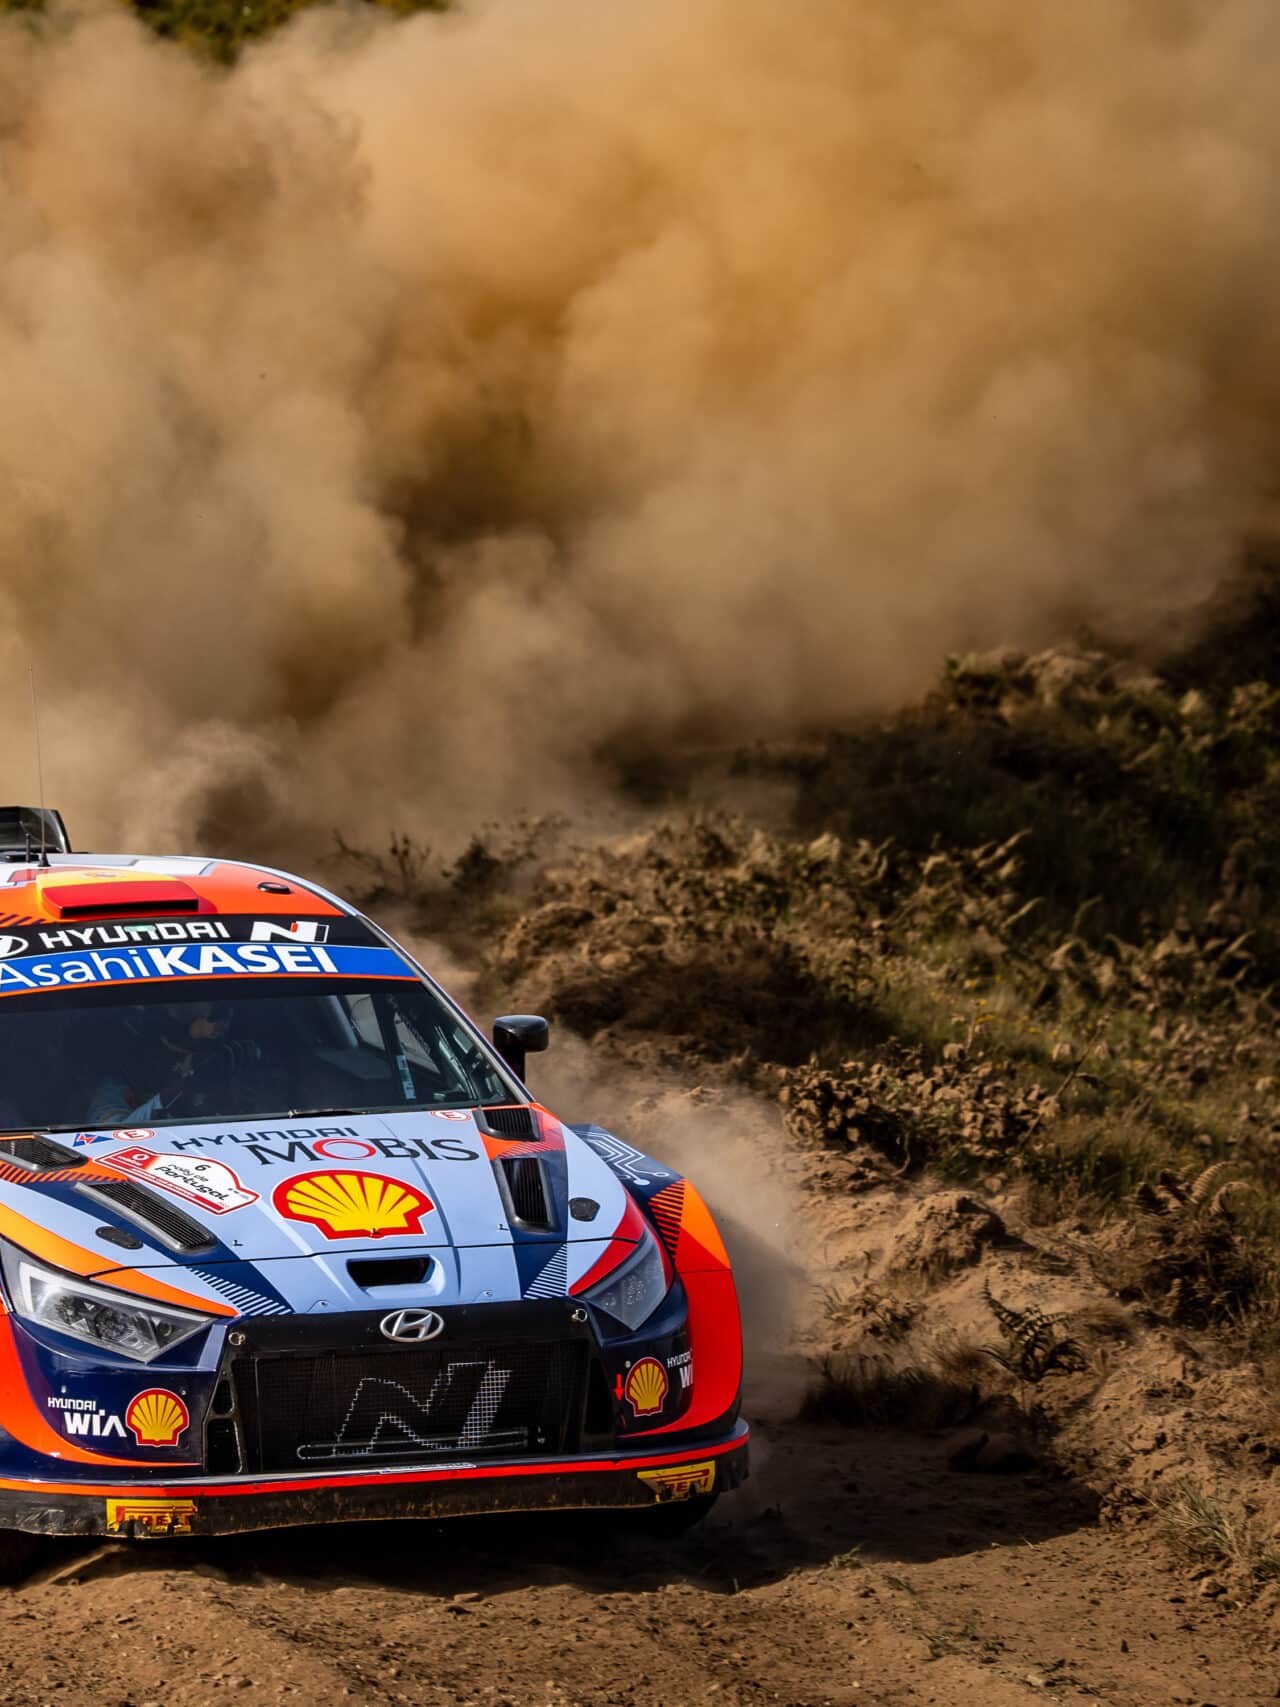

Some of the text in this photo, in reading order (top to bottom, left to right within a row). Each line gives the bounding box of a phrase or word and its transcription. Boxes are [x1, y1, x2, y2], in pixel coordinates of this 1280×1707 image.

[39, 921, 231, 949] HYUNDAI
[170, 1127, 360, 1150] HYUNDAI
[243, 1138, 480, 1165] MOBIS
[154, 1166, 229, 1200] Portugal
[48, 1397, 96, 1411] HYUNDAI
[64, 1409, 128, 1437] WIA
